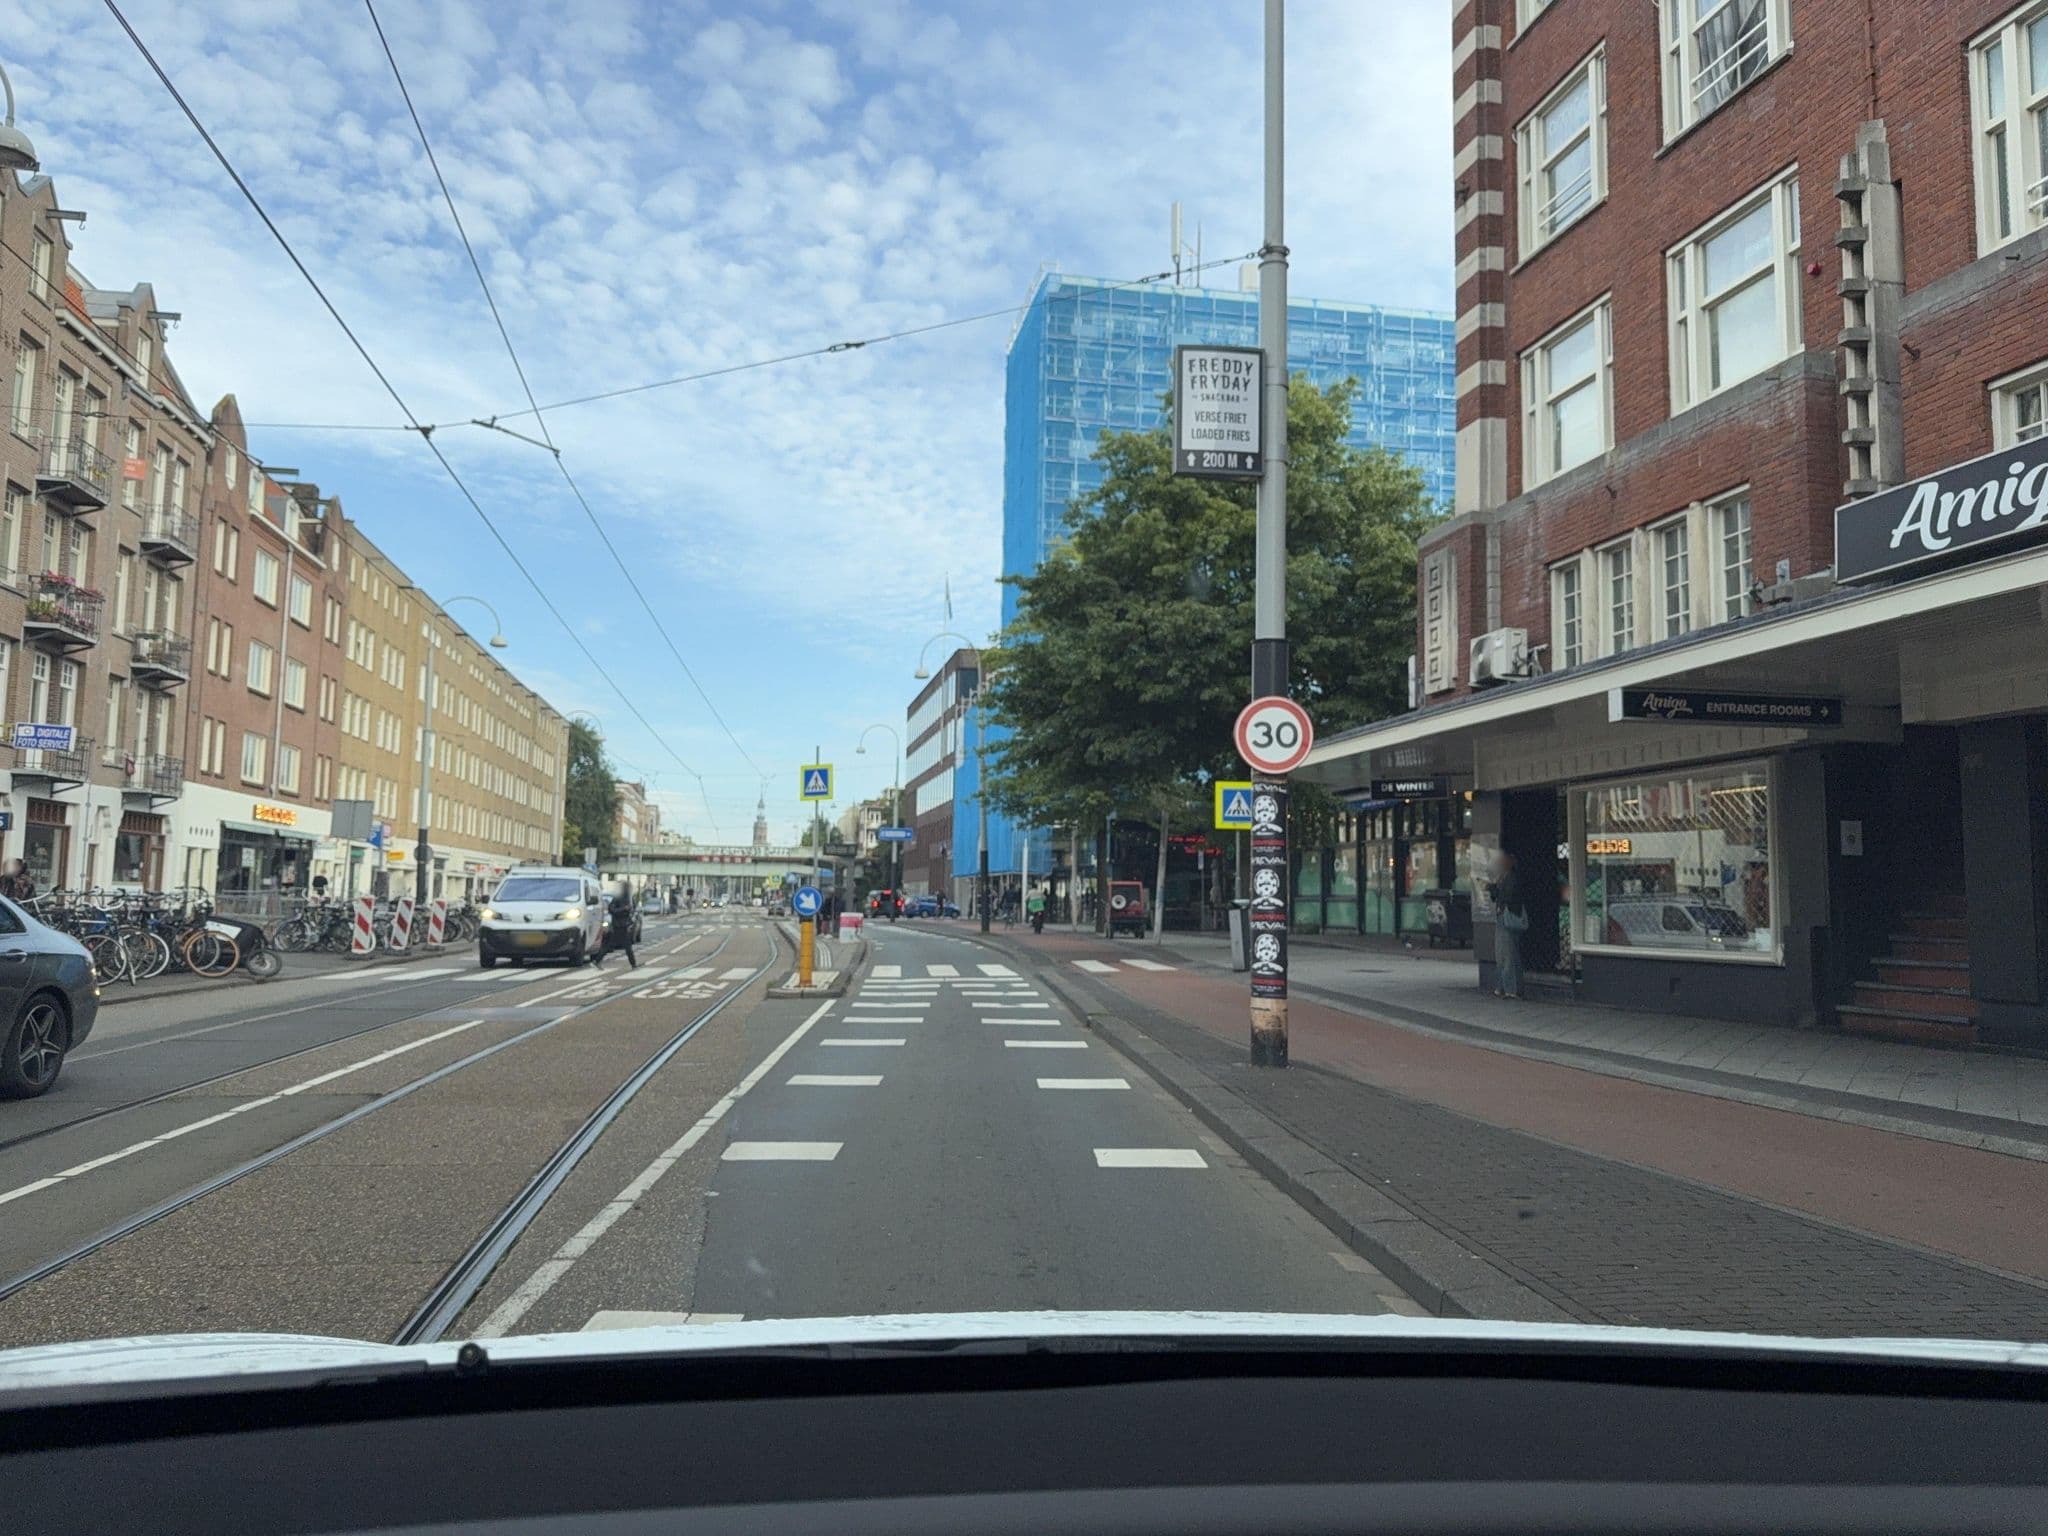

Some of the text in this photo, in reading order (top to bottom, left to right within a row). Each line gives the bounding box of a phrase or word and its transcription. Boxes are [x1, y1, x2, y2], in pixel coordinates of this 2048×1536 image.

[1188, 358, 1253, 376] FREDDY
[1190, 374, 1251, 392] FRYDAY
[1195, 411, 1247, 424] VERSE FRIET
[1191, 428, 1250, 442] LOADED FRIES
[1203, 452, 1238, 468] 200 M
[1643, 692, 1694, 719] Amigo
[1706, 702, 1768, 715] ENTRANCE
[1769, 704, 1812, 717] ROOMS
[36, 728, 71, 739] DIGITALE
[1252, 721, 1299, 749] 30
[17, 738, 69, 750] FOTO SERVICE
